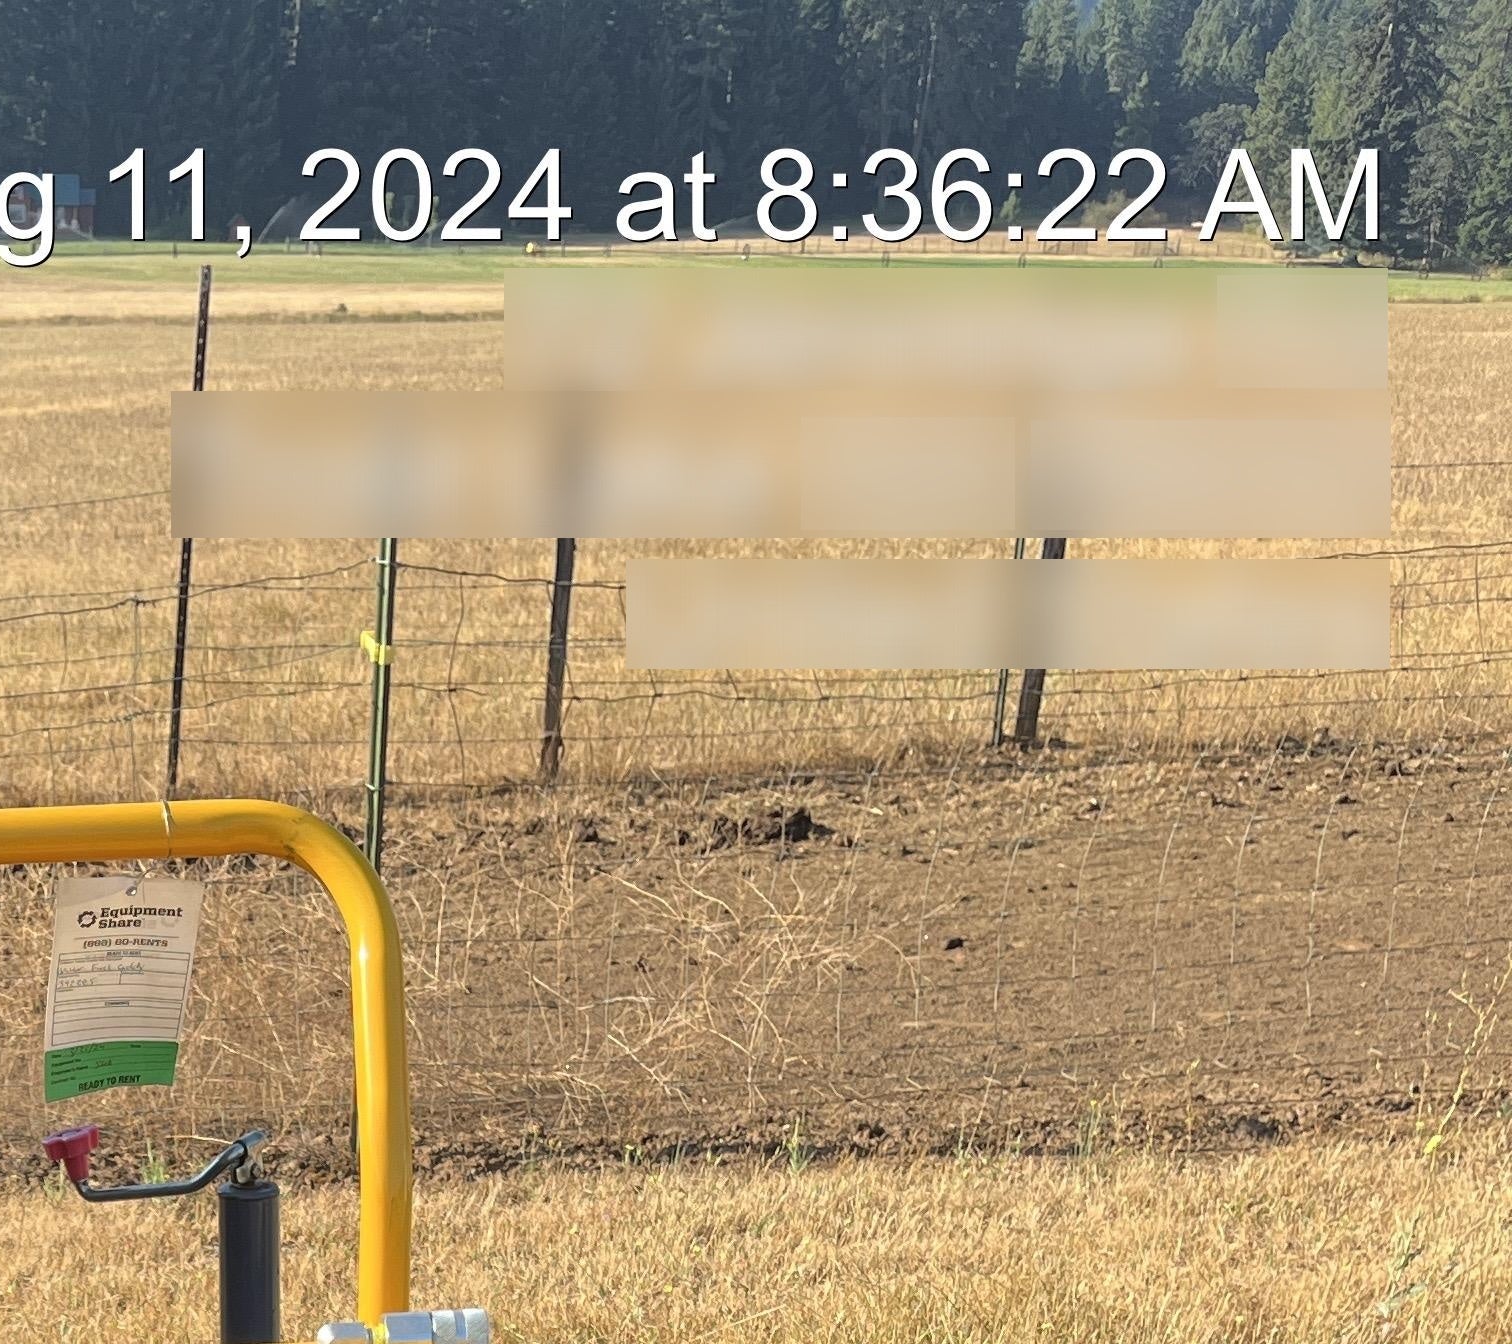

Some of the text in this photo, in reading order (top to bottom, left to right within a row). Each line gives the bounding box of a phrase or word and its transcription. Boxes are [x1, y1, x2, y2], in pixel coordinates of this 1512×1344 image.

[99, 905, 183, 918] Equipment
[98, 919, 142, 929] Share
[79, 1079, 104, 1092] READY
[107, 1076, 117, 1085] TO
[118, 1075, 141, 1084] RENT
